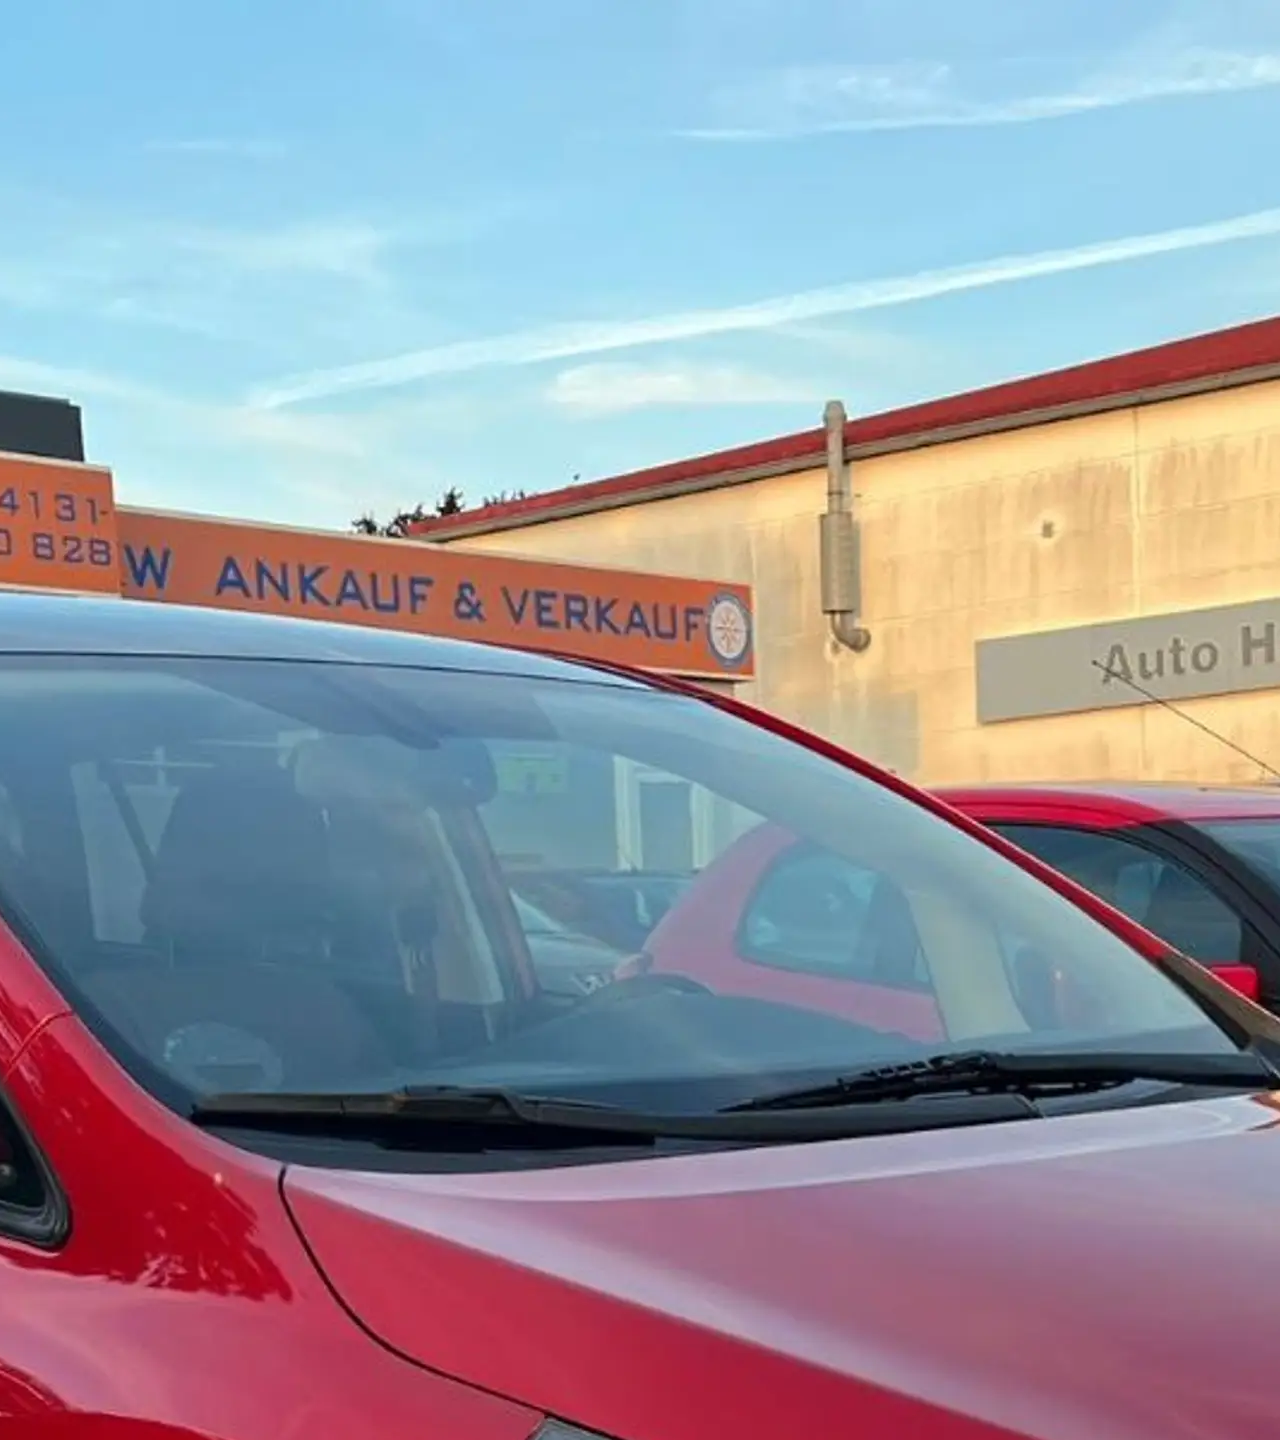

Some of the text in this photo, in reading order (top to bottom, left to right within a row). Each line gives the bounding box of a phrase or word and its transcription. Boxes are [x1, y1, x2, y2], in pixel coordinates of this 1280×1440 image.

[32, 533, 112, 566] 828
[122, 543, 172, 590] W
[214, 556, 435, 615] ANKAUF
[453, 582, 487, 623] &
[500, 586, 705, 642] VERKAUF
[1101, 637, 1219, 685] Auto
